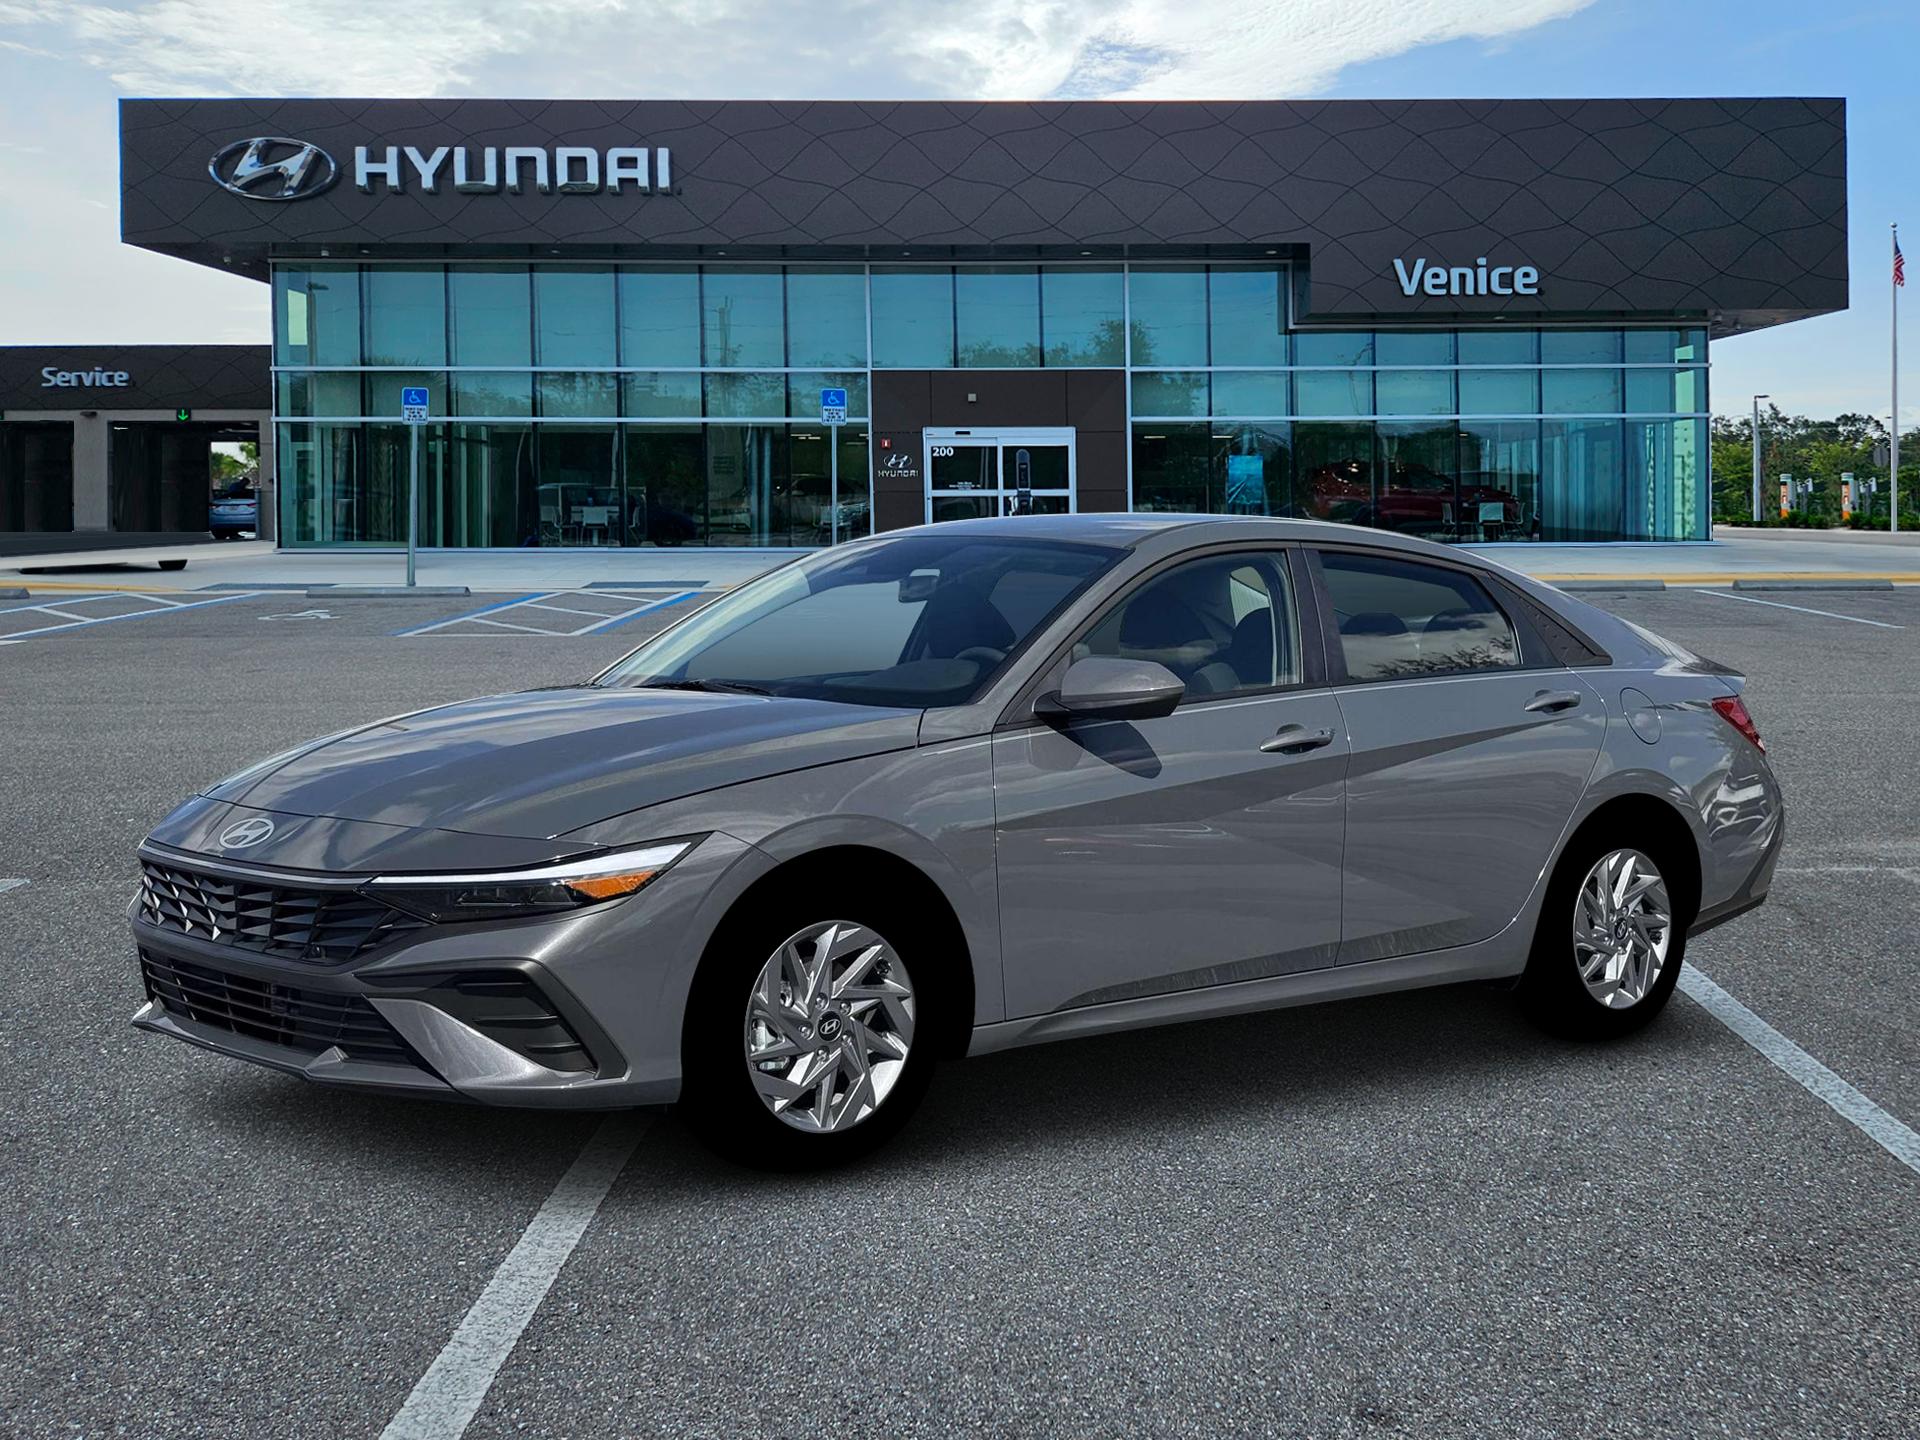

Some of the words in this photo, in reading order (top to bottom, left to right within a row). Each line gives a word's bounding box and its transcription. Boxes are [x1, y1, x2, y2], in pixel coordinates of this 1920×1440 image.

[354, 146, 671, 193] HYUNDAI
[1392, 256, 1539, 297] Venice
[41, 366, 129, 387] Service
[932, 446, 954, 457] 200
[877, 469, 919, 478] HYUNDAI
